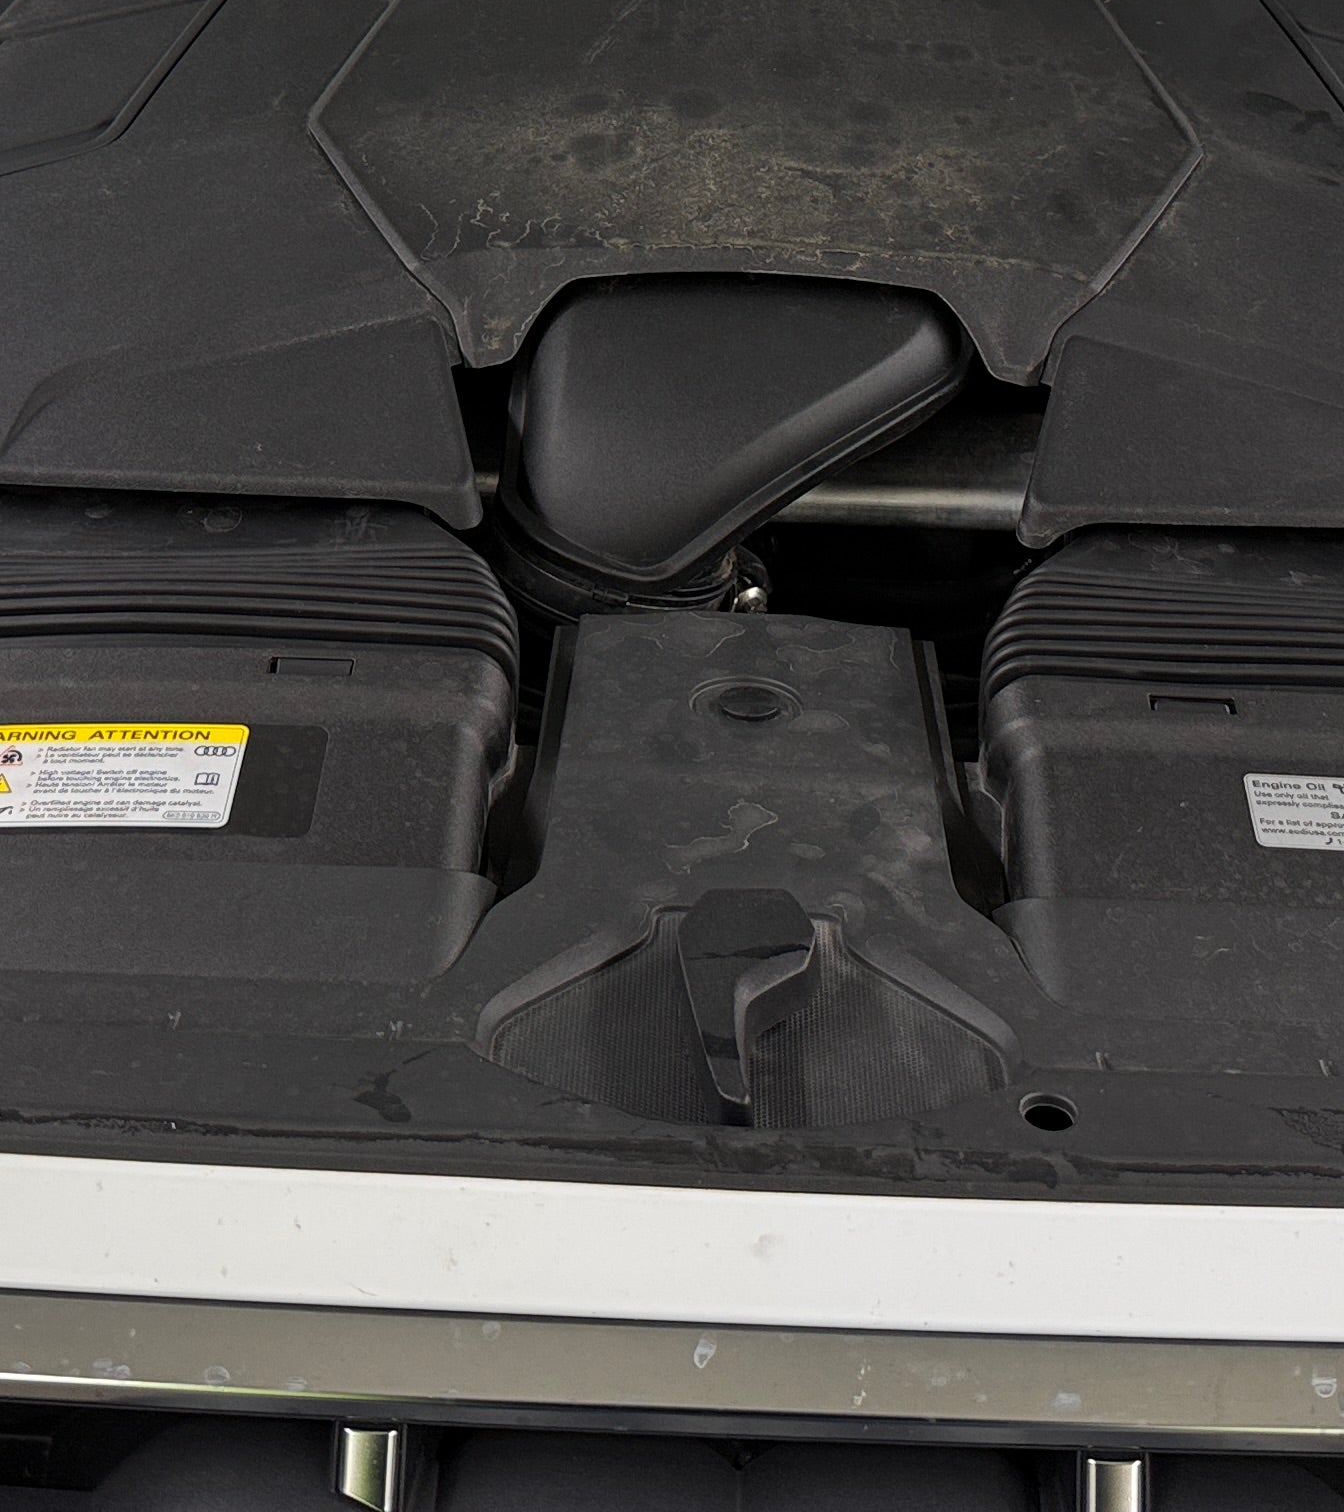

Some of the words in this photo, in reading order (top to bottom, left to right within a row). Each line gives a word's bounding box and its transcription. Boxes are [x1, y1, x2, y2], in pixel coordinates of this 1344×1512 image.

[88, 730, 212, 741] ATTENTION
[1252, 780, 1301, 790] Engine
[1306, 782, 1326, 791] Oil
[1256, 800, 1299, 808] expressly
